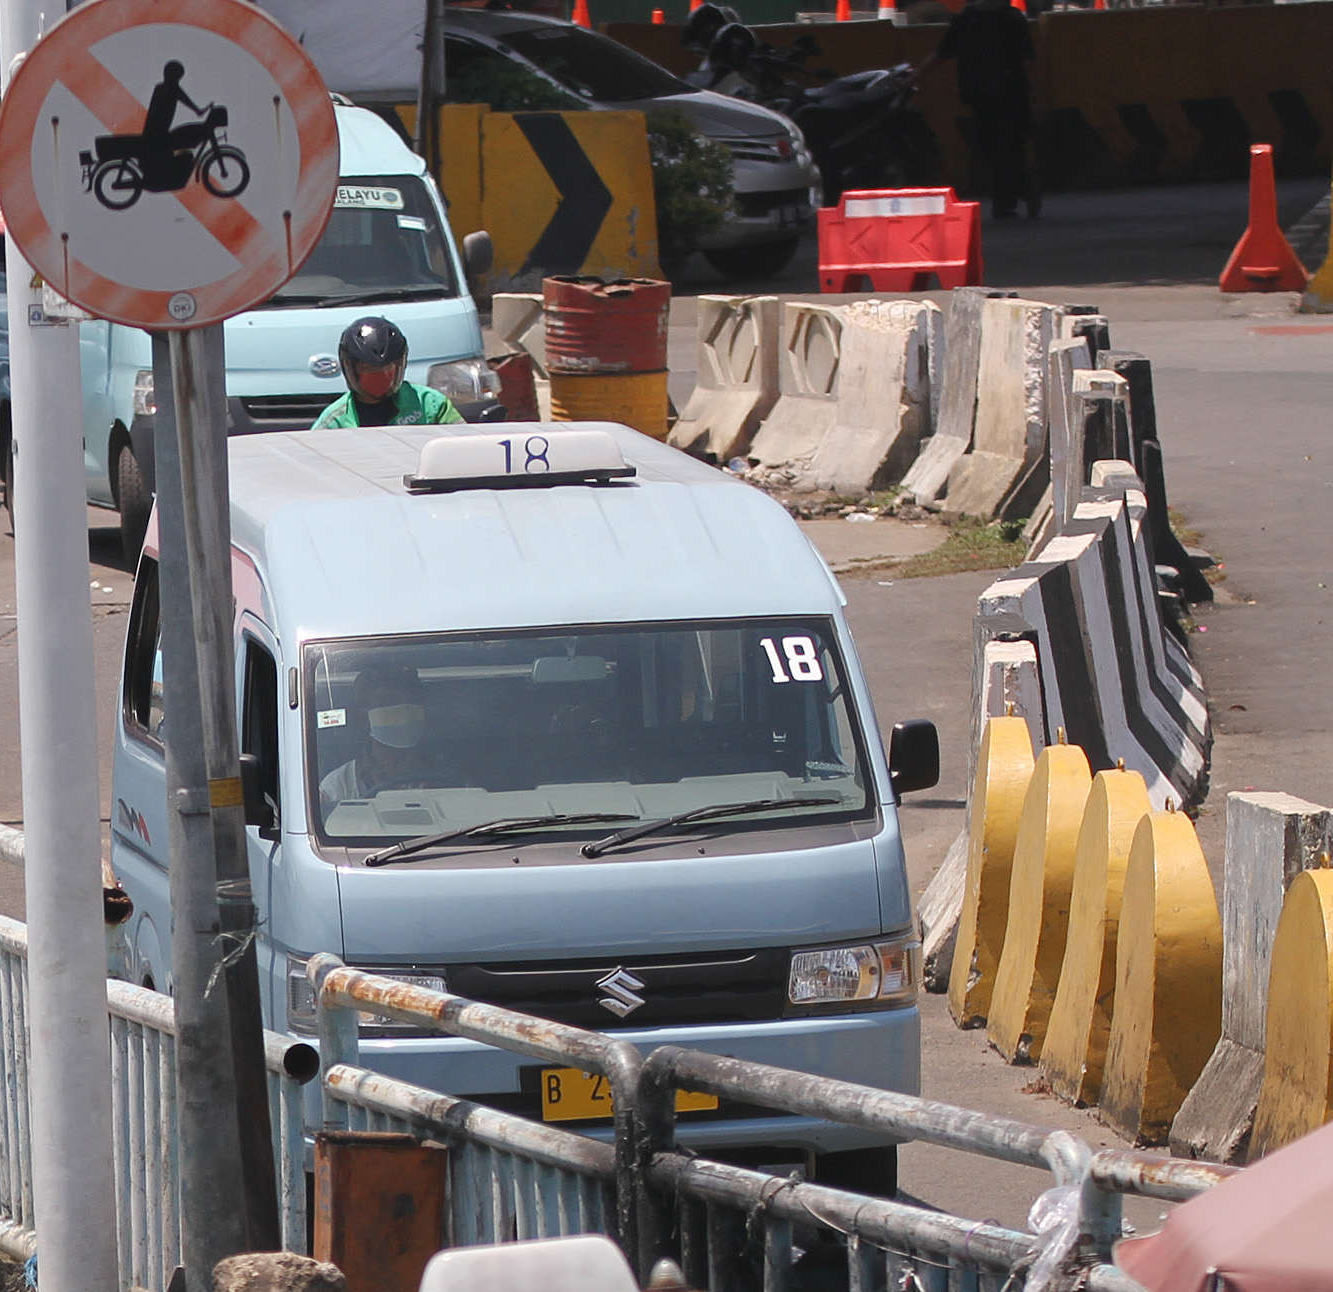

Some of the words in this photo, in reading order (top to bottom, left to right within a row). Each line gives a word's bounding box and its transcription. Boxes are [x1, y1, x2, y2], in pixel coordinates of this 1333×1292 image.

[336, 189, 381, 200] ELAYU
[497, 435, 551, 474] 18
[759, 635, 824, 684] 18
[547, 1074, 562, 1104] B
